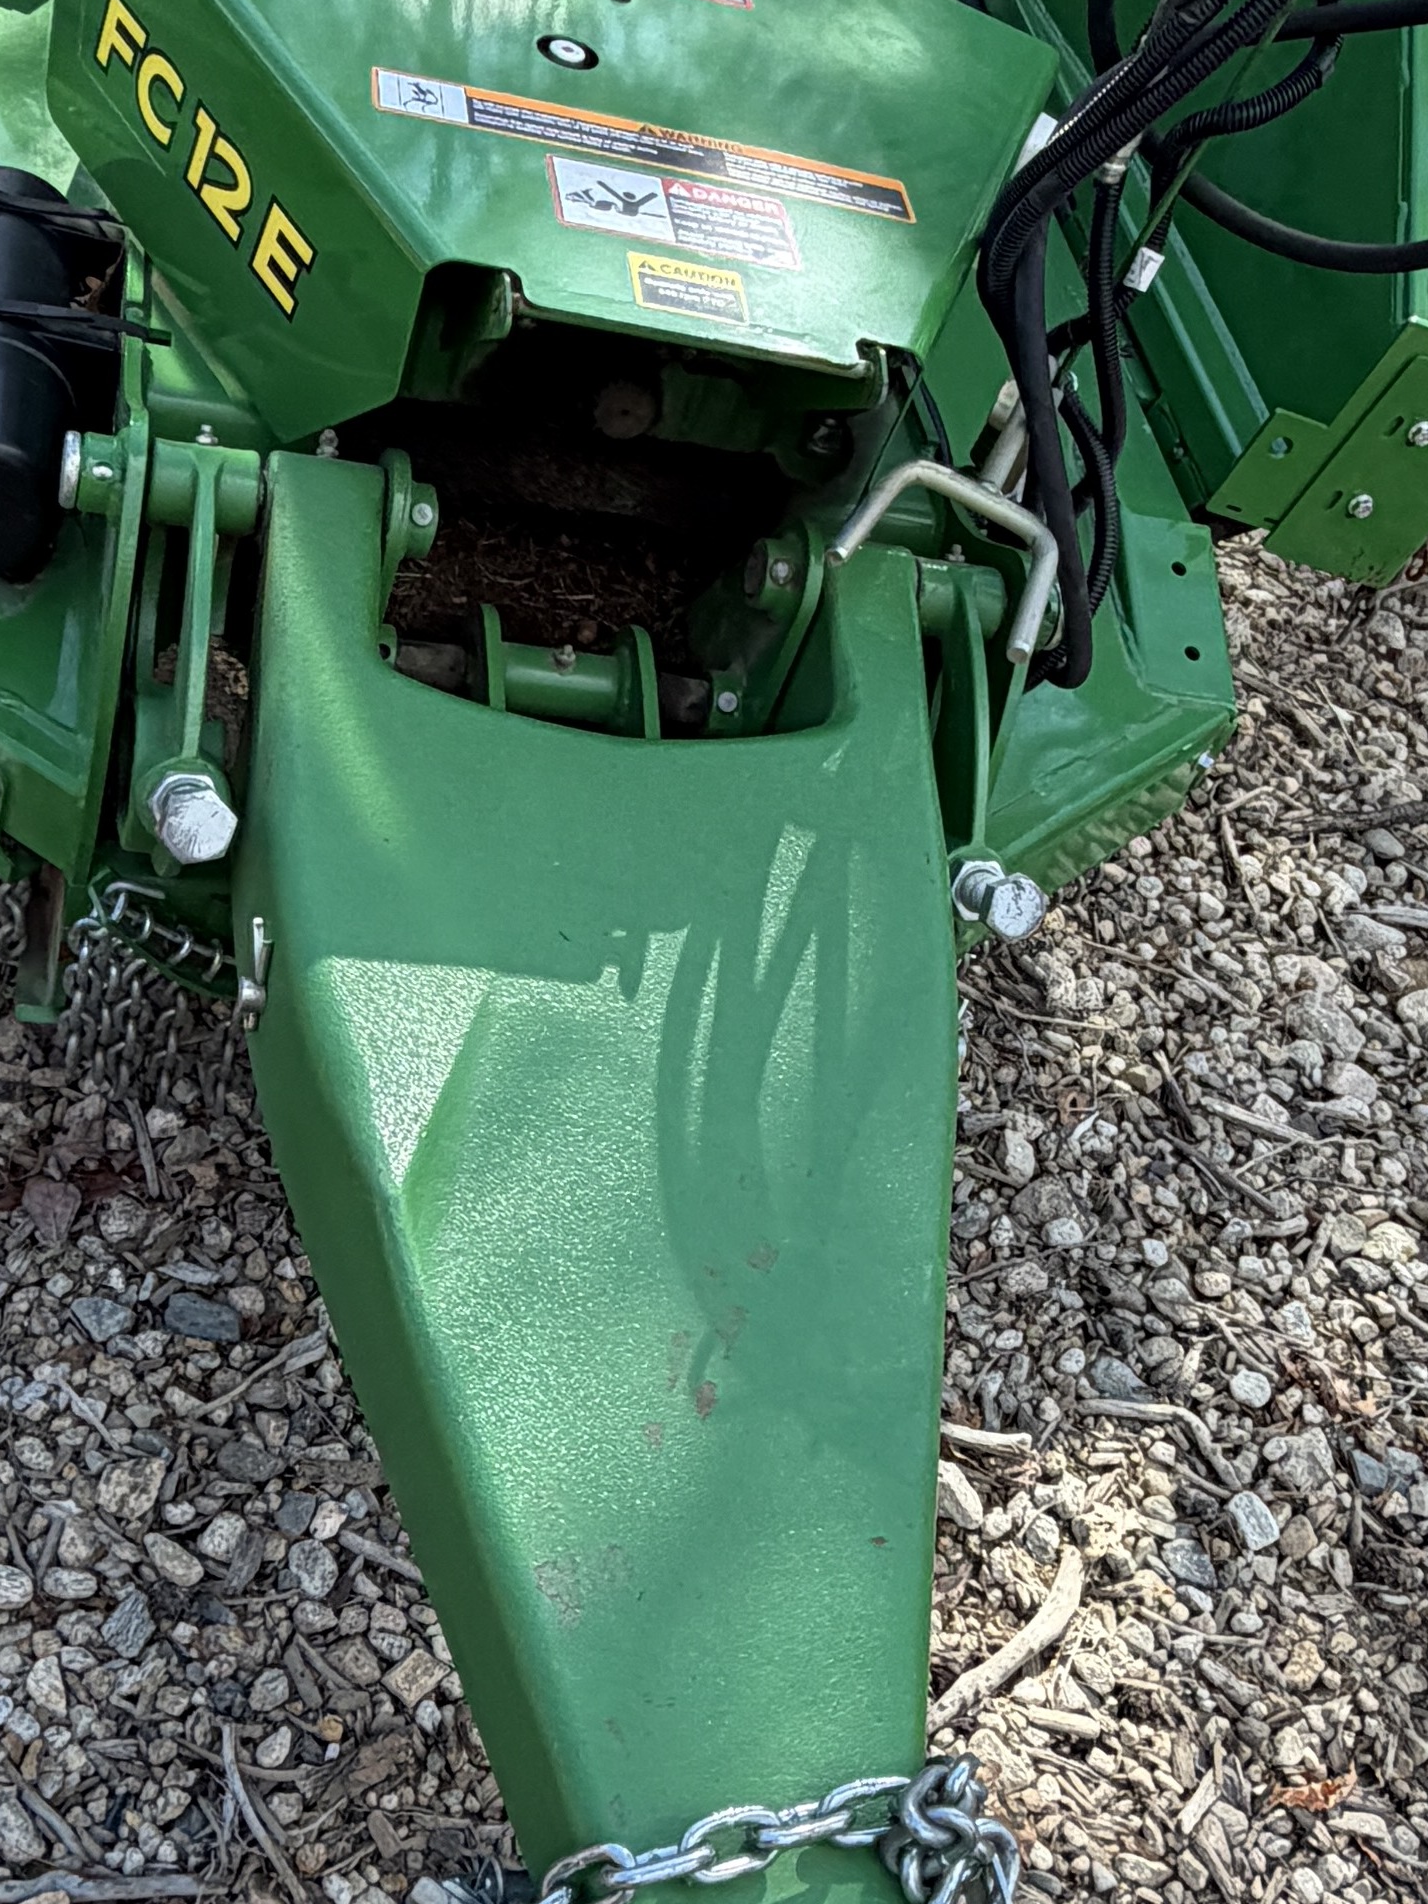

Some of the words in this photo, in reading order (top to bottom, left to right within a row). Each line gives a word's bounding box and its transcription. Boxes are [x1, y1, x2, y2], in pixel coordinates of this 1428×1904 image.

[659, 128, 744, 153] WARNING
[692, 187, 781, 215] DANGER
[659, 264, 736, 286] CAUTION
